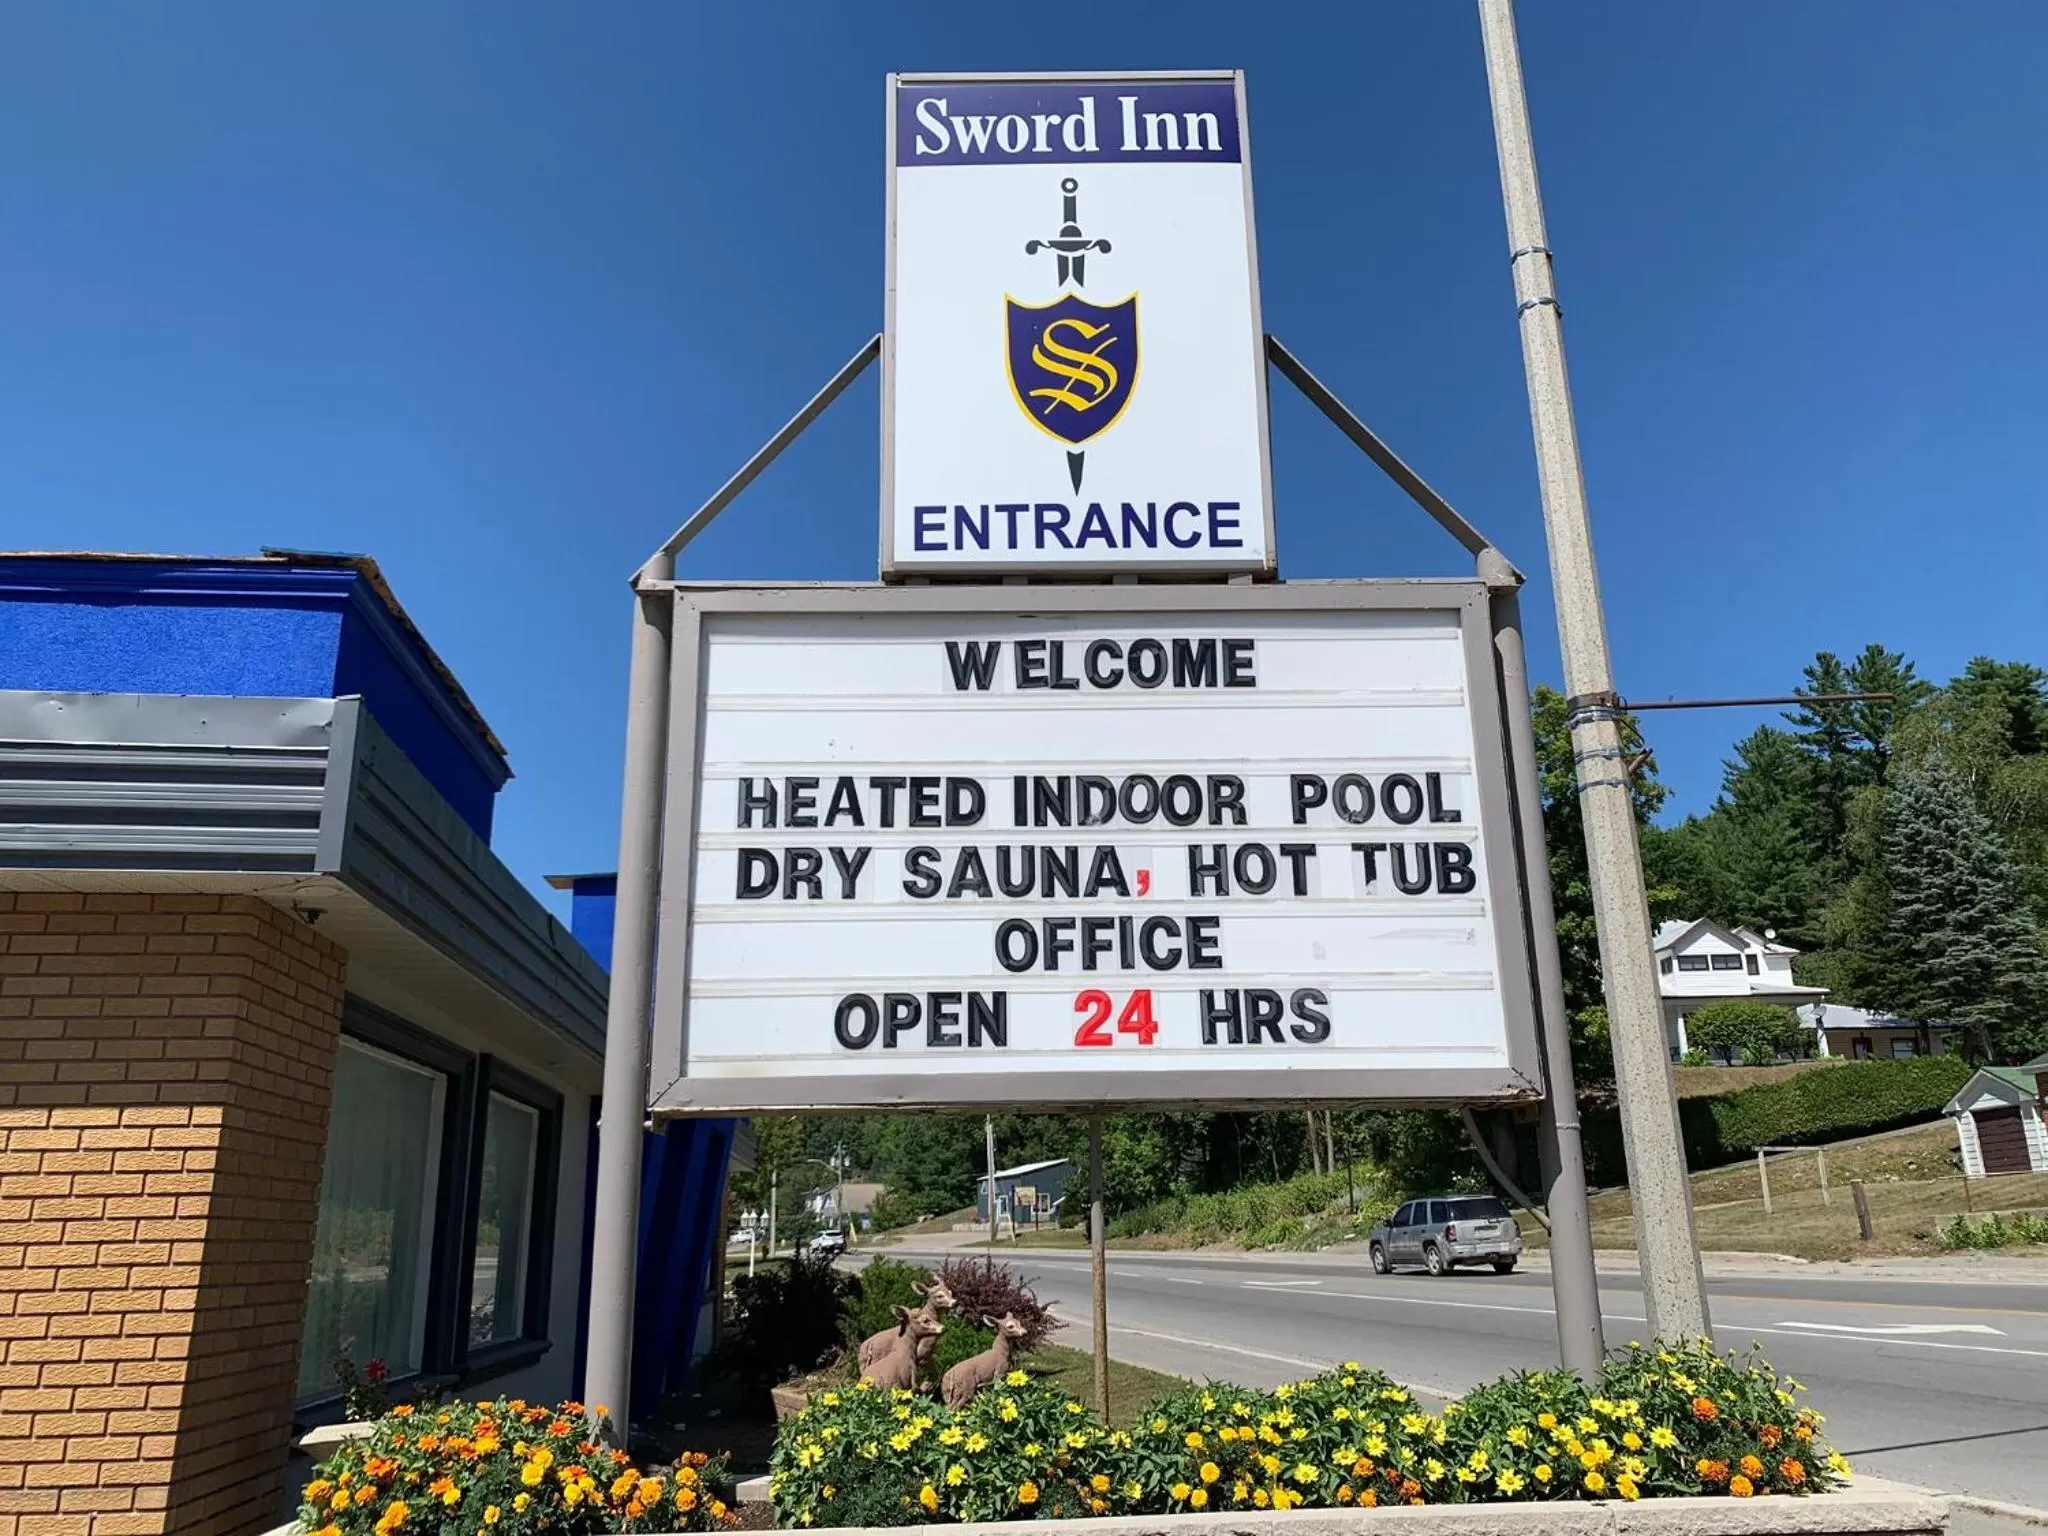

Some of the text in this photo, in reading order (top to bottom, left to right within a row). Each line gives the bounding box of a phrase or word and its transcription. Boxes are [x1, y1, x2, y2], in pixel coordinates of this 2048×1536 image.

[915, 96, 1222, 155] Sword Inn
[915, 502, 1243, 551] ENTRANCE
[945, 639, 1256, 690] WELCOME
[738, 772, 1461, 828] HEATED INDOOR POOL
[737, 842, 1476, 899] DRY SAUNA, HOT TUB
[995, 916, 1222, 972] OFFICE
[834, 988, 1330, 1050] OPEN 24 HRS
